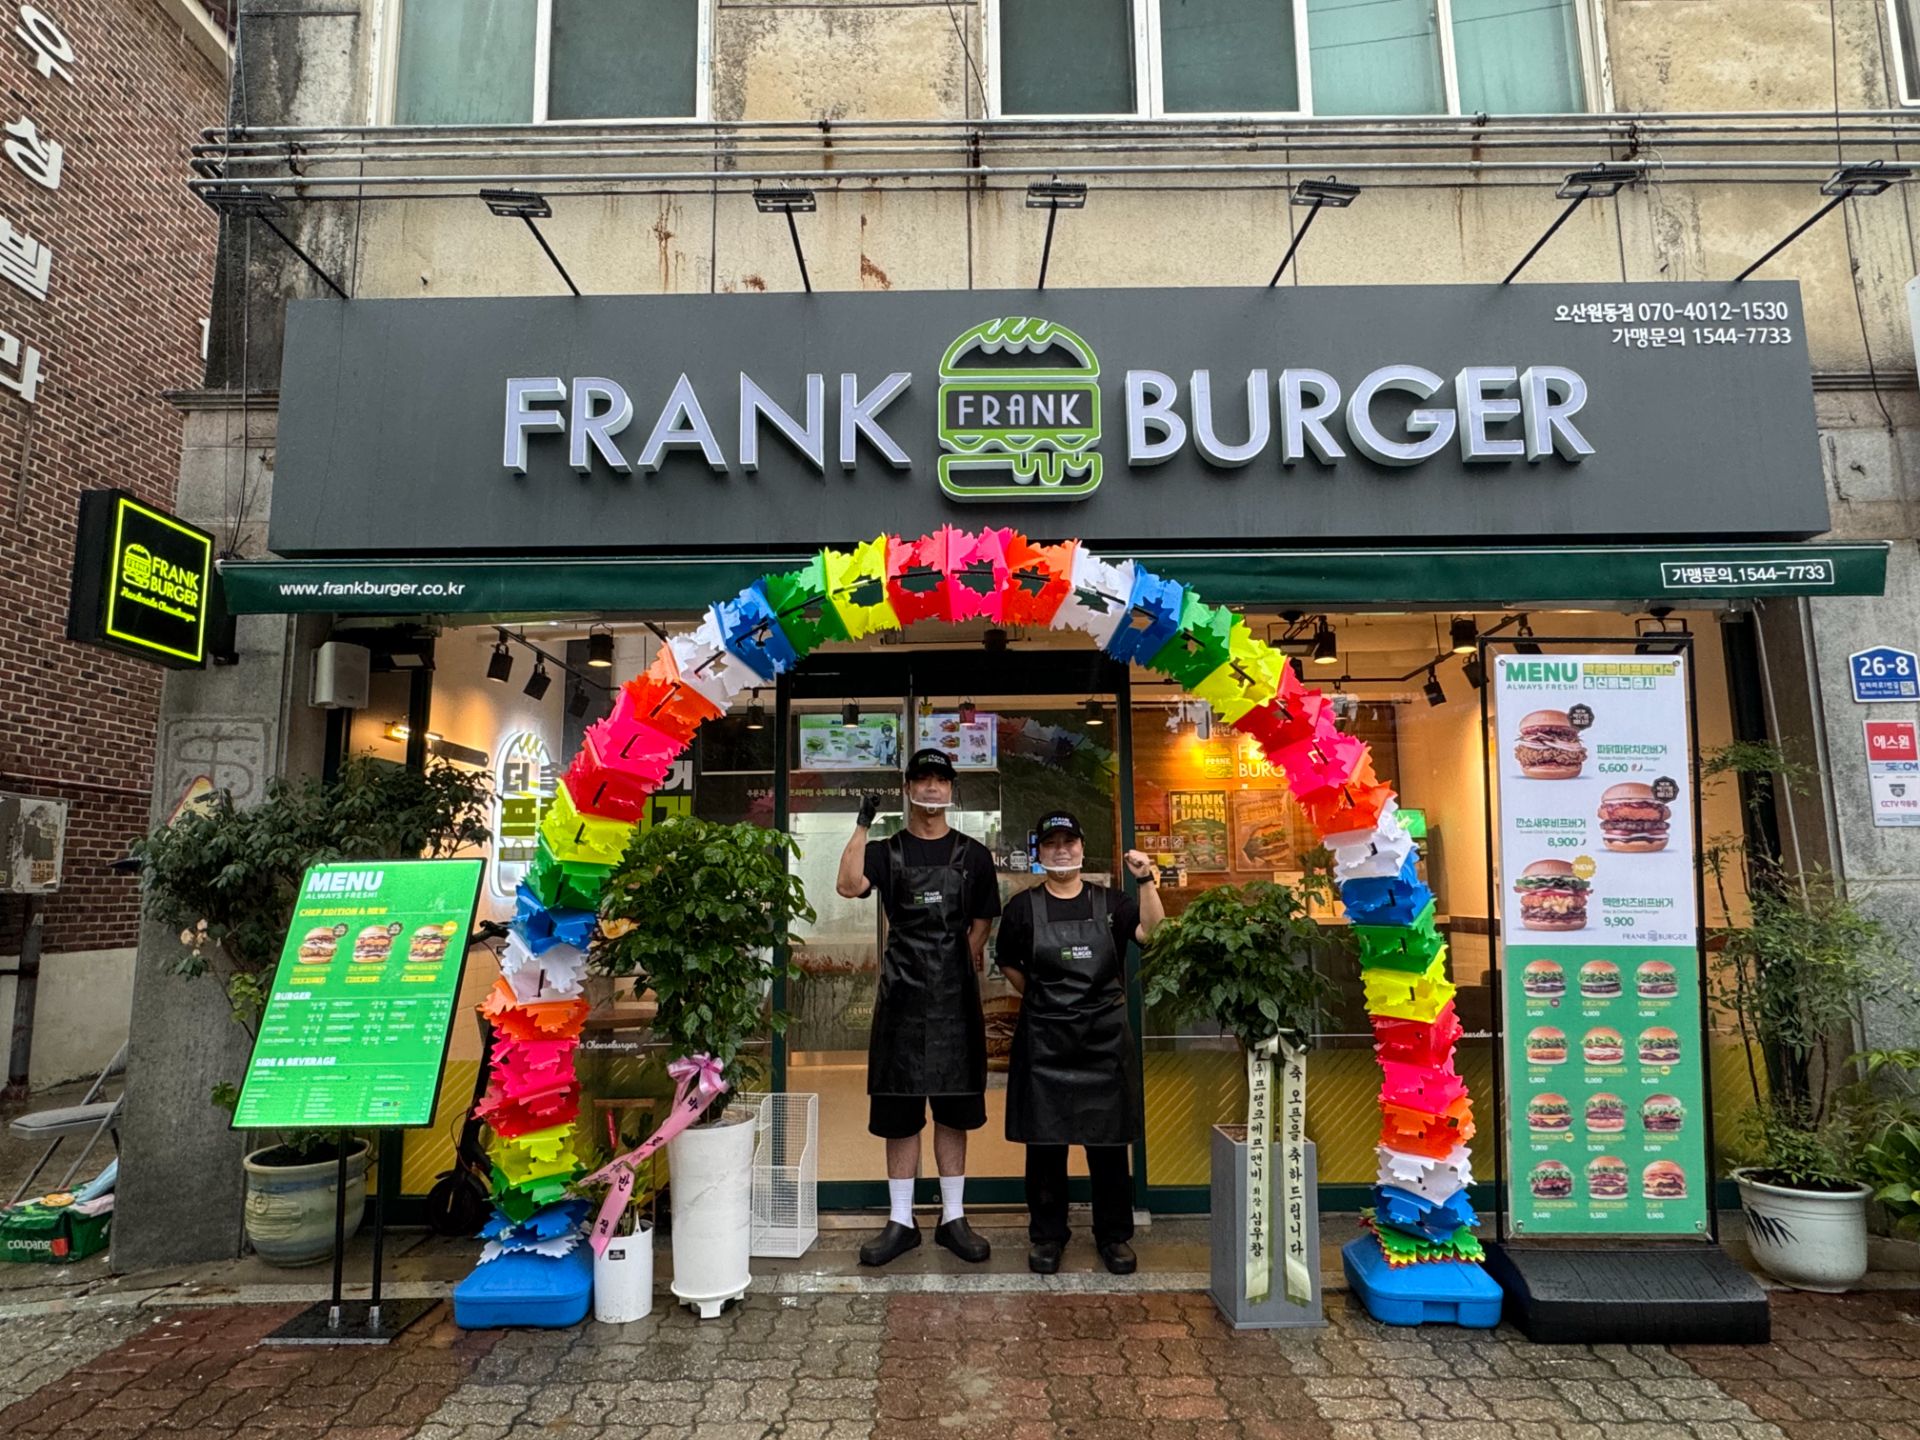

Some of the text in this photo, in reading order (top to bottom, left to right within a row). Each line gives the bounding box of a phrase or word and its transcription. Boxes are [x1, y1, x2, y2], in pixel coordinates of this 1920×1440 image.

[1554, 302, 1789, 324] 오산원동점 070-4012-1530
[1612, 327, 1792, 348] 가맹문의 1544-7733
[503, 364, 1596, 474] FRANK FRANK BURGER
[152, 556, 200, 592] FRANK
[150, 576, 199, 608] BURGER
[280, 580, 466, 597] www.frankburger.co.kr
[1505, 662, 1578, 682] MENU
[1859, 656, 1910, 676] 26-8
[1506, 683, 1578, 691] ALWAYS FRESH!
[1873, 735, 1911, 750] 에스원
[1238, 762, 1287, 778] BURG
[1598, 763, 1629, 774] 6,600
[1171, 793, 1225, 806] FRANK
[1881, 800, 1899, 808] CCTV
[1171, 807, 1227, 825] LUNCH
[1547, 837, 1579, 848] 8,900
[306, 870, 384, 892] MENU
[304, 891, 378, 900] ALWAYS FRESH!
[1603, 916, 1635, 928] 9,900
[1658, 933, 1689, 941] BURGER
[274, 991, 312, 1001] BURGER
[586, 1040, 638, 1050] Cheeseburger
[255, 1058, 277, 1067] SIDE
[285, 1057, 337, 1066] BEVERAGE
[1288, 1064, 1303, 1082] 축
[1288, 1089, 1303, 1142] 오픈을
[7, 1239, 52, 1252] coupang
